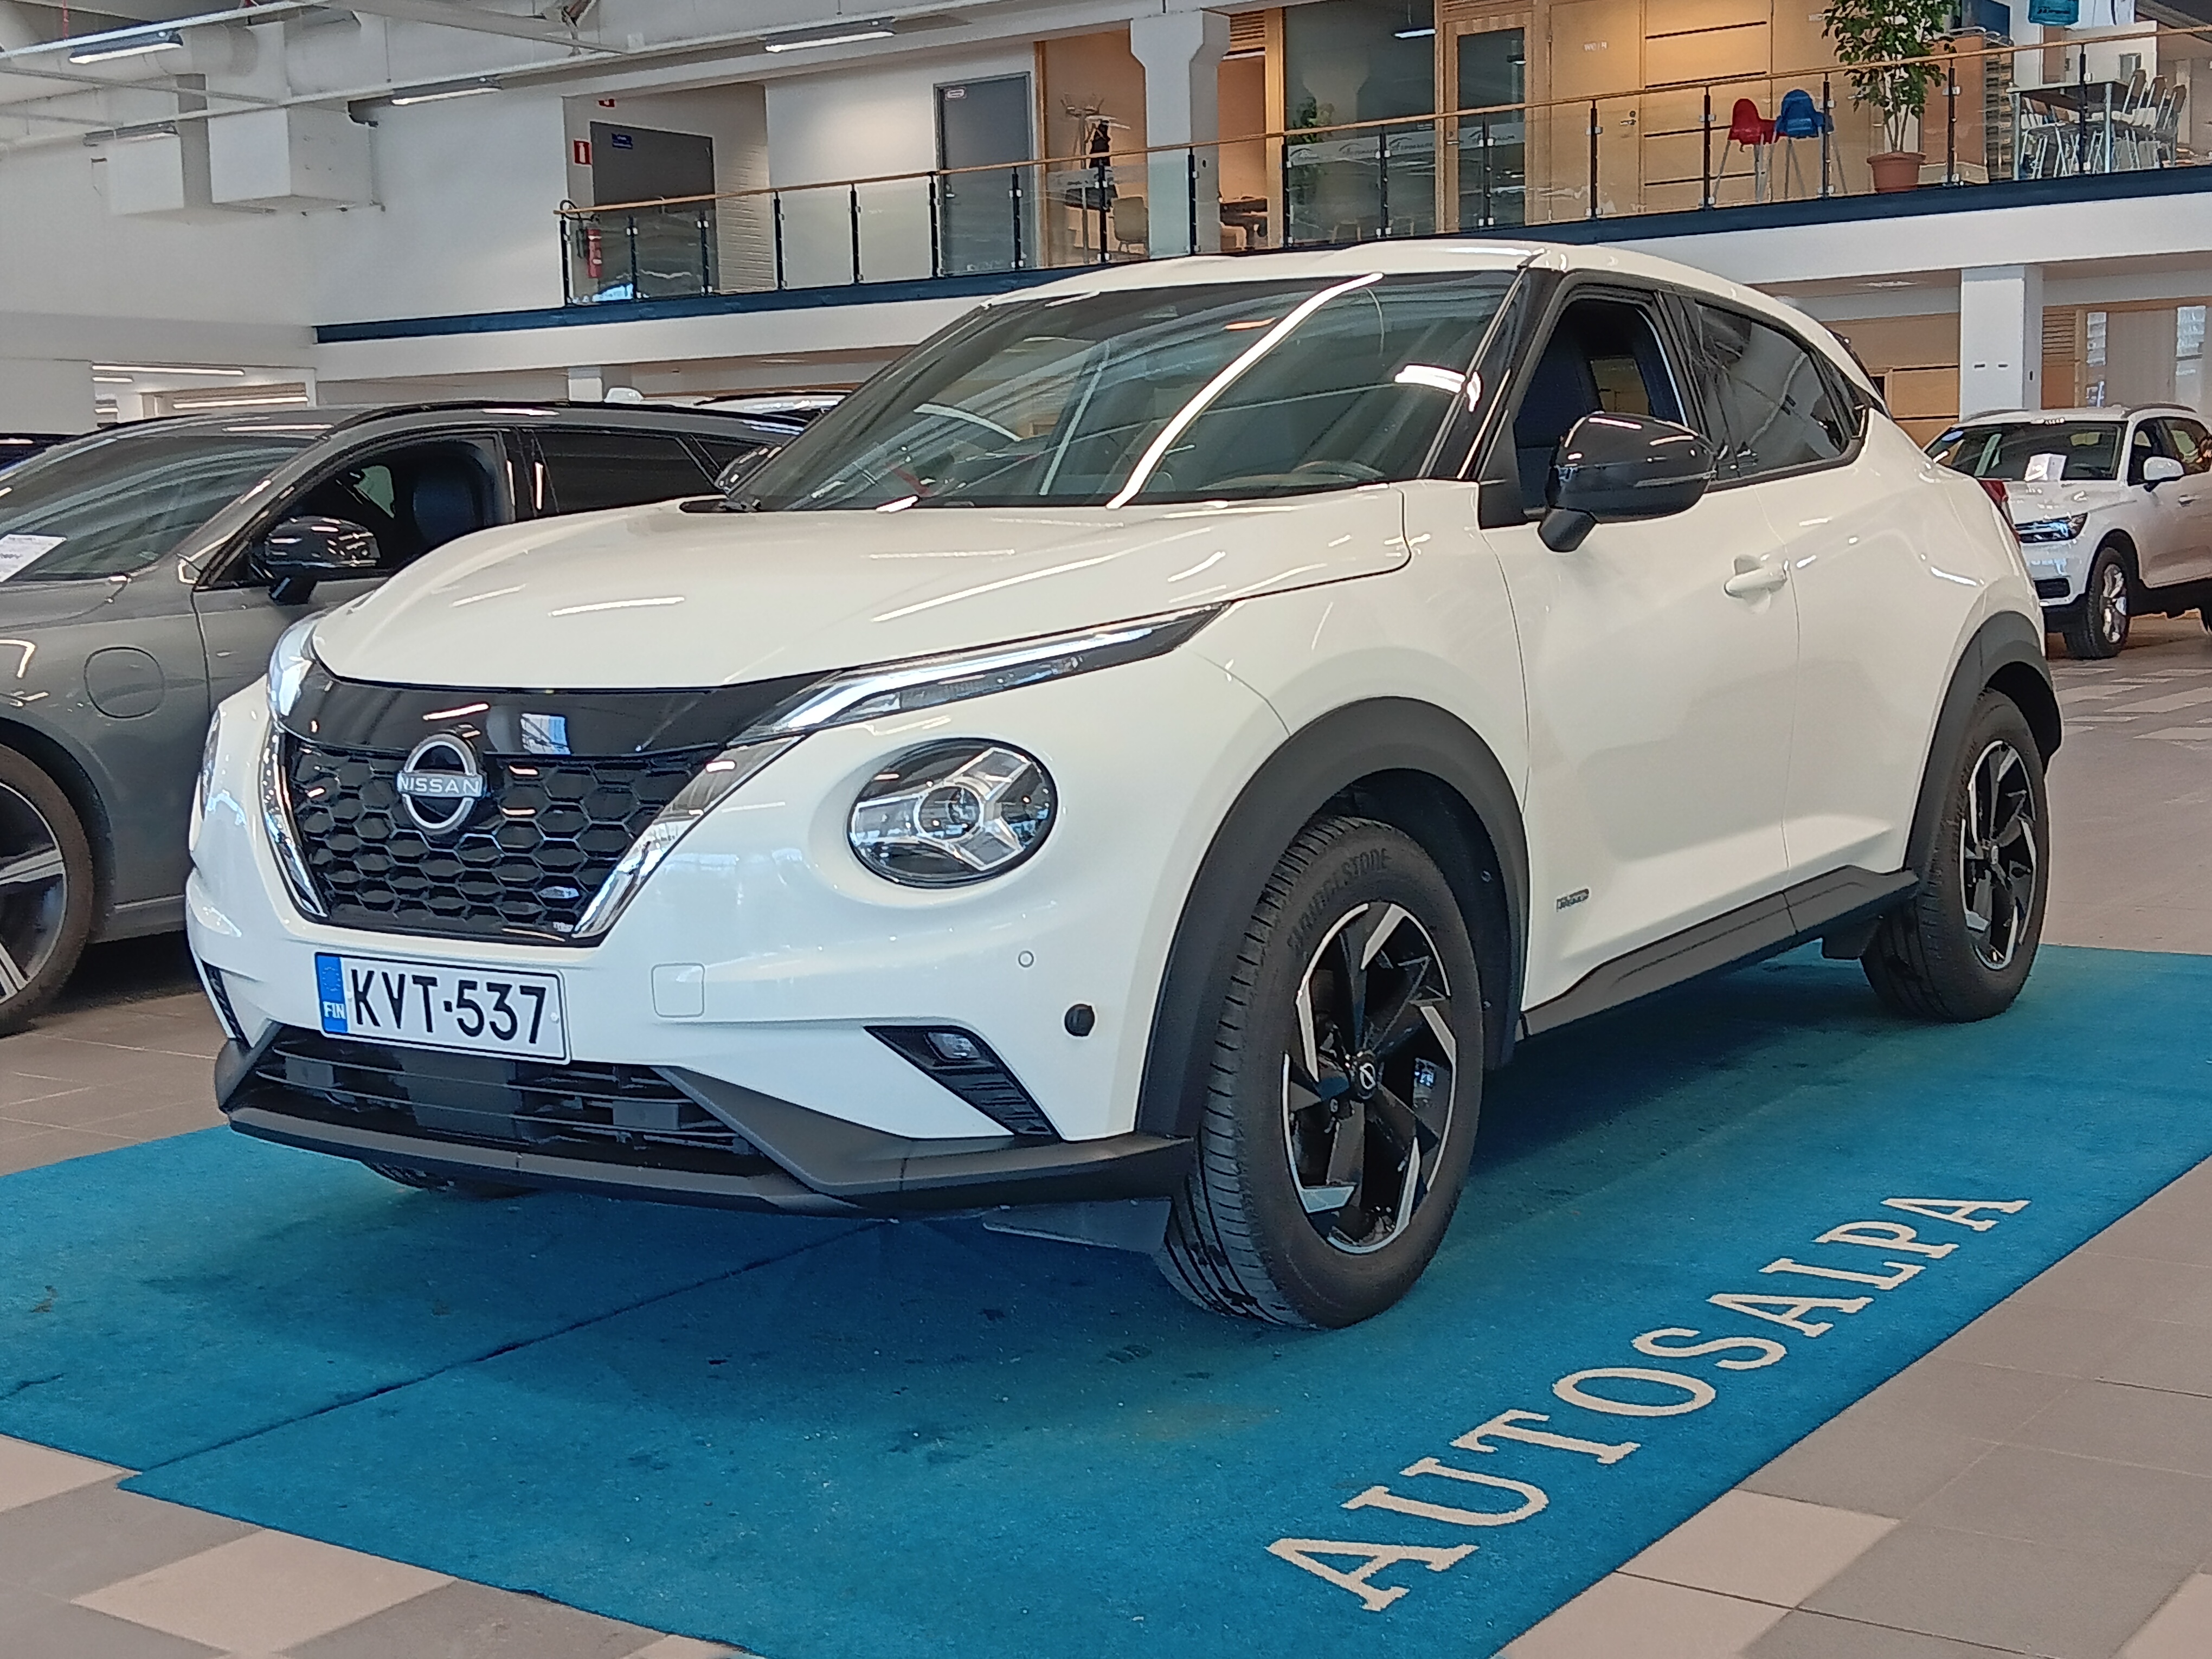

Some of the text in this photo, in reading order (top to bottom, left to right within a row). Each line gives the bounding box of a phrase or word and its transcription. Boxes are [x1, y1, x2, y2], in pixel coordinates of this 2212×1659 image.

[397, 774, 479, 795] NISSAN
[323, 1001, 346, 1019] FIN
[1266, 1198, 2030, 1612] AUTOSALPA
